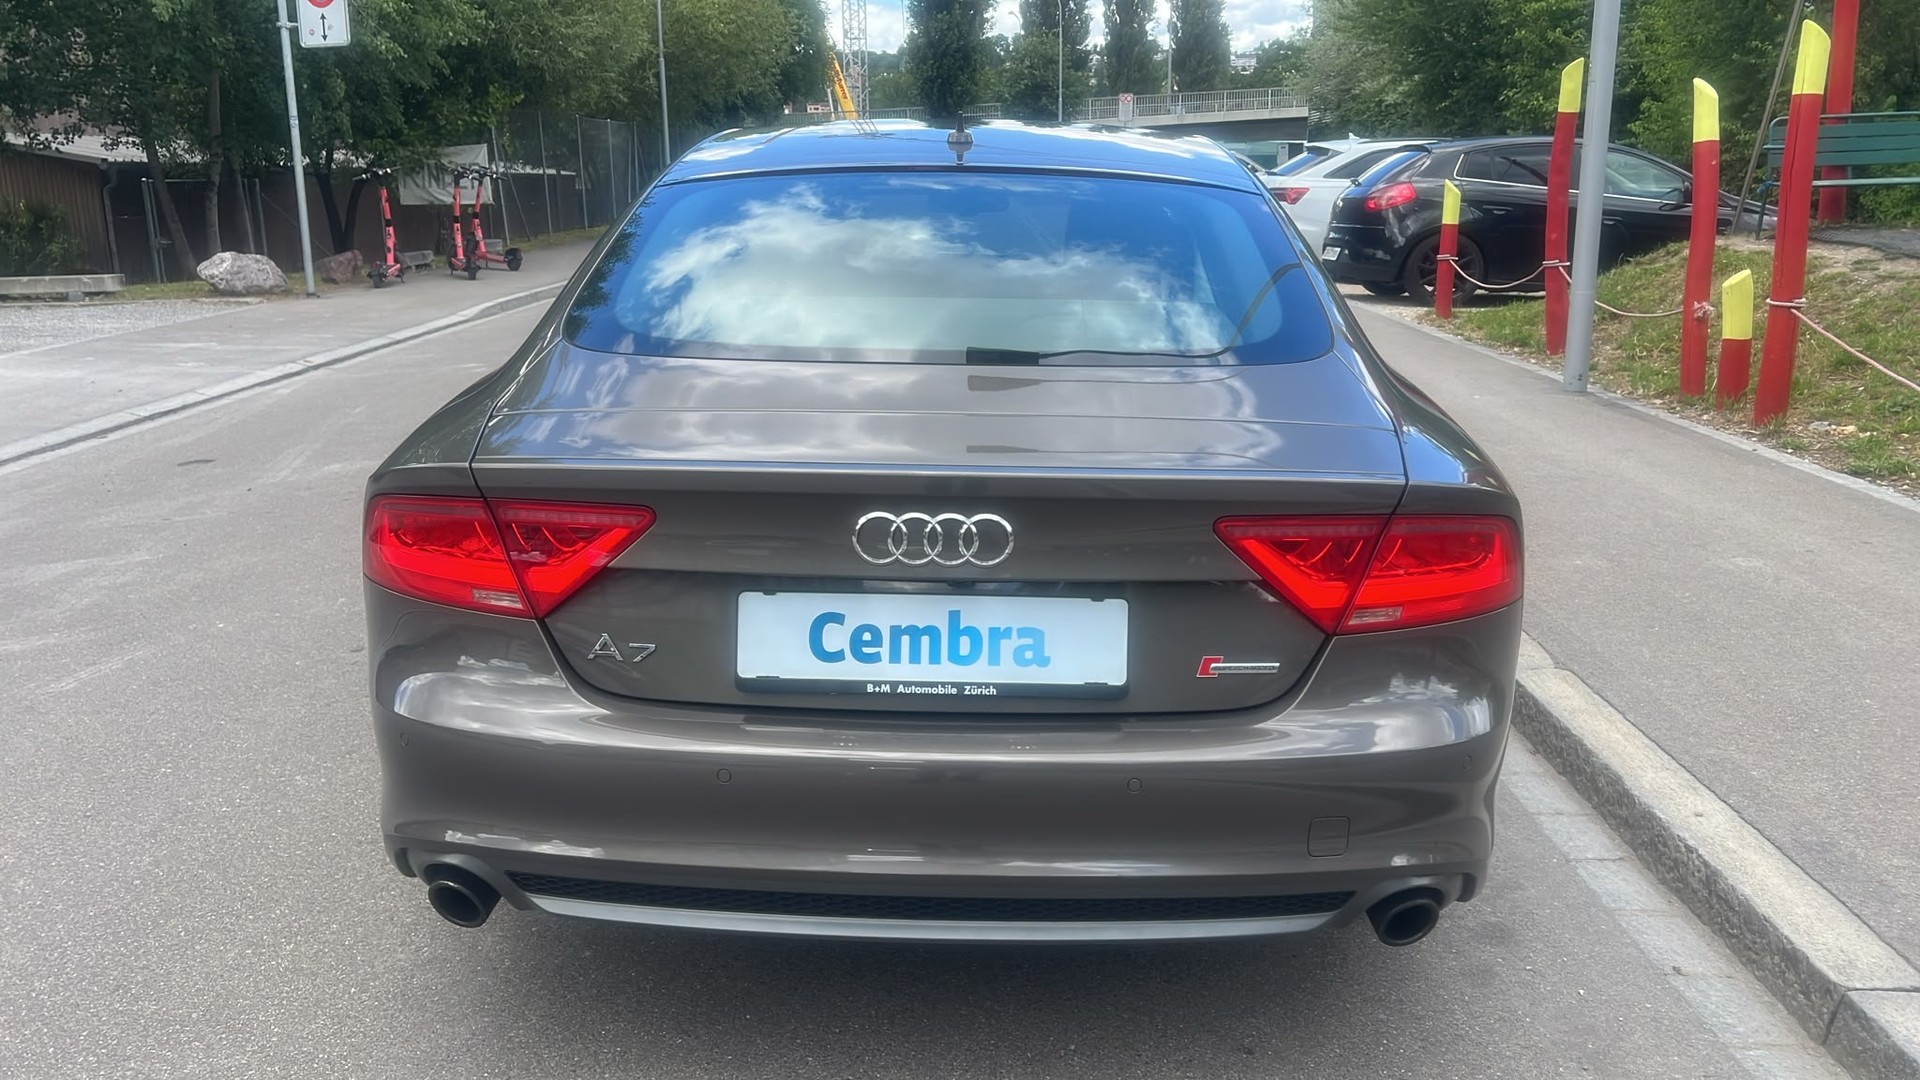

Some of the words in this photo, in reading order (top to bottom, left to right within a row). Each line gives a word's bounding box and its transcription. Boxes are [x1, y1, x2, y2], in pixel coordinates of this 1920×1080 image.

[587, 633, 656, 663] A7
[808, 610, 1050, 668] Cembra
[866, 683, 891, 693] B+M
[896, 684, 958, 695] Automobile
[963, 685, 997, 696] Zürich
